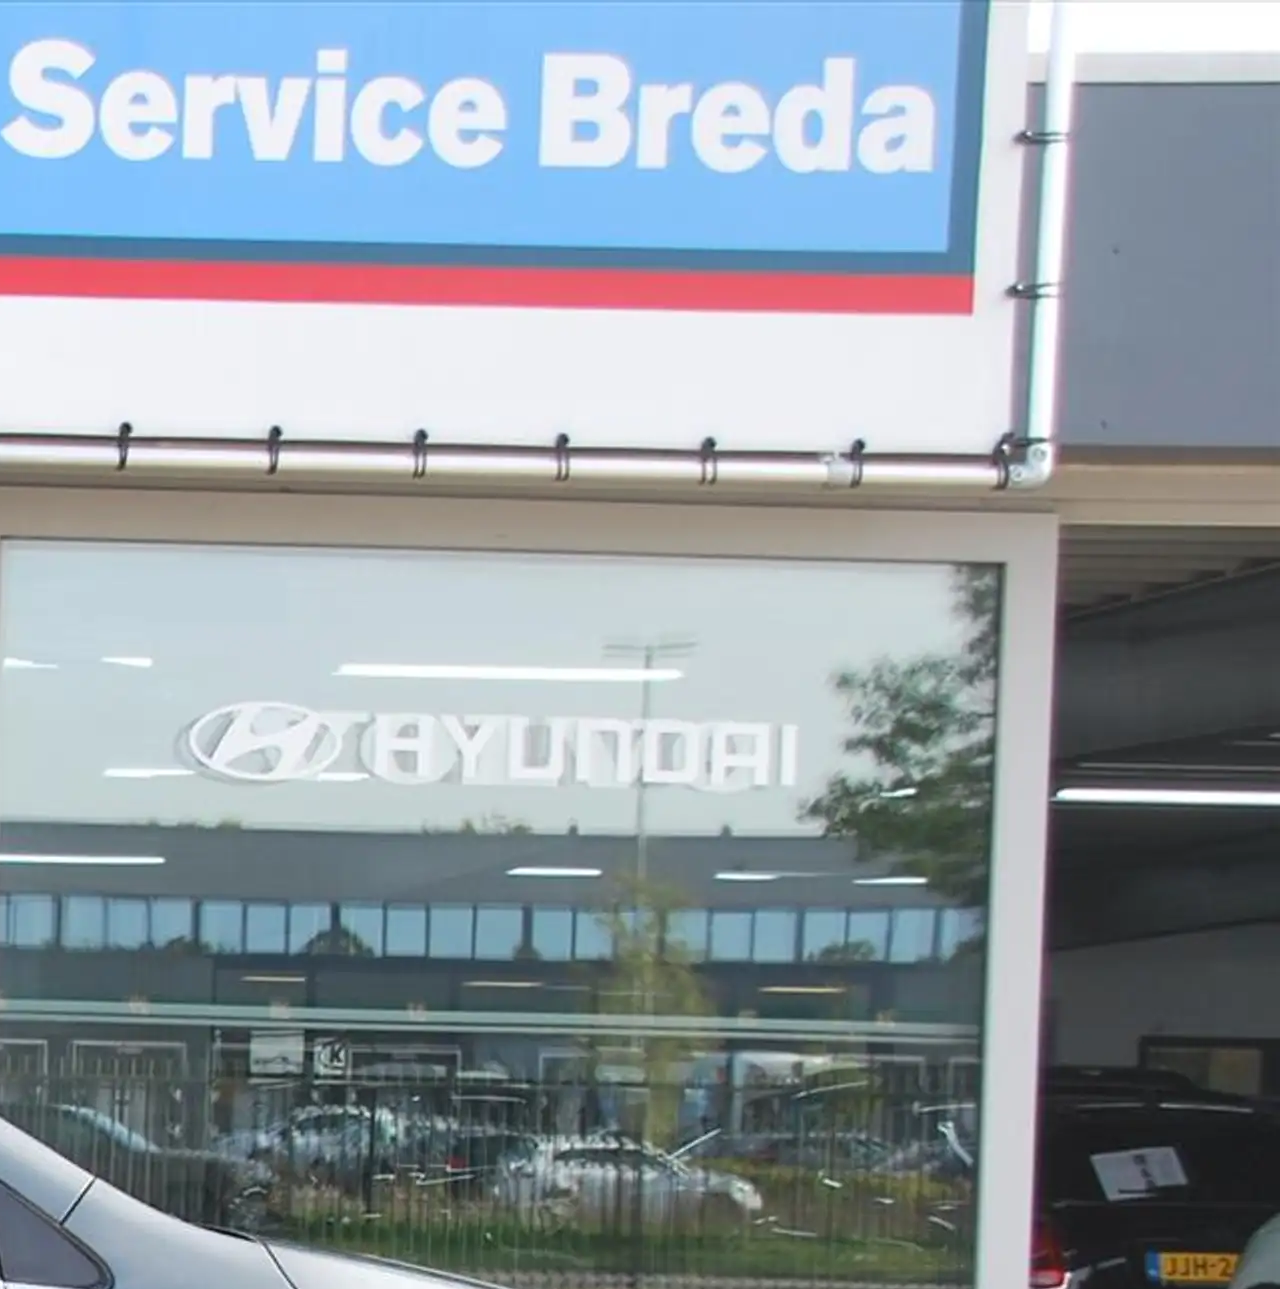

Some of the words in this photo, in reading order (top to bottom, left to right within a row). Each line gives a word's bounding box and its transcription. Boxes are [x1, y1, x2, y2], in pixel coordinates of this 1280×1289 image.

[0, 38, 507, 171] Service
[539, 53, 935, 174] Breda
[374, 713, 800, 787] HYUNDAI
